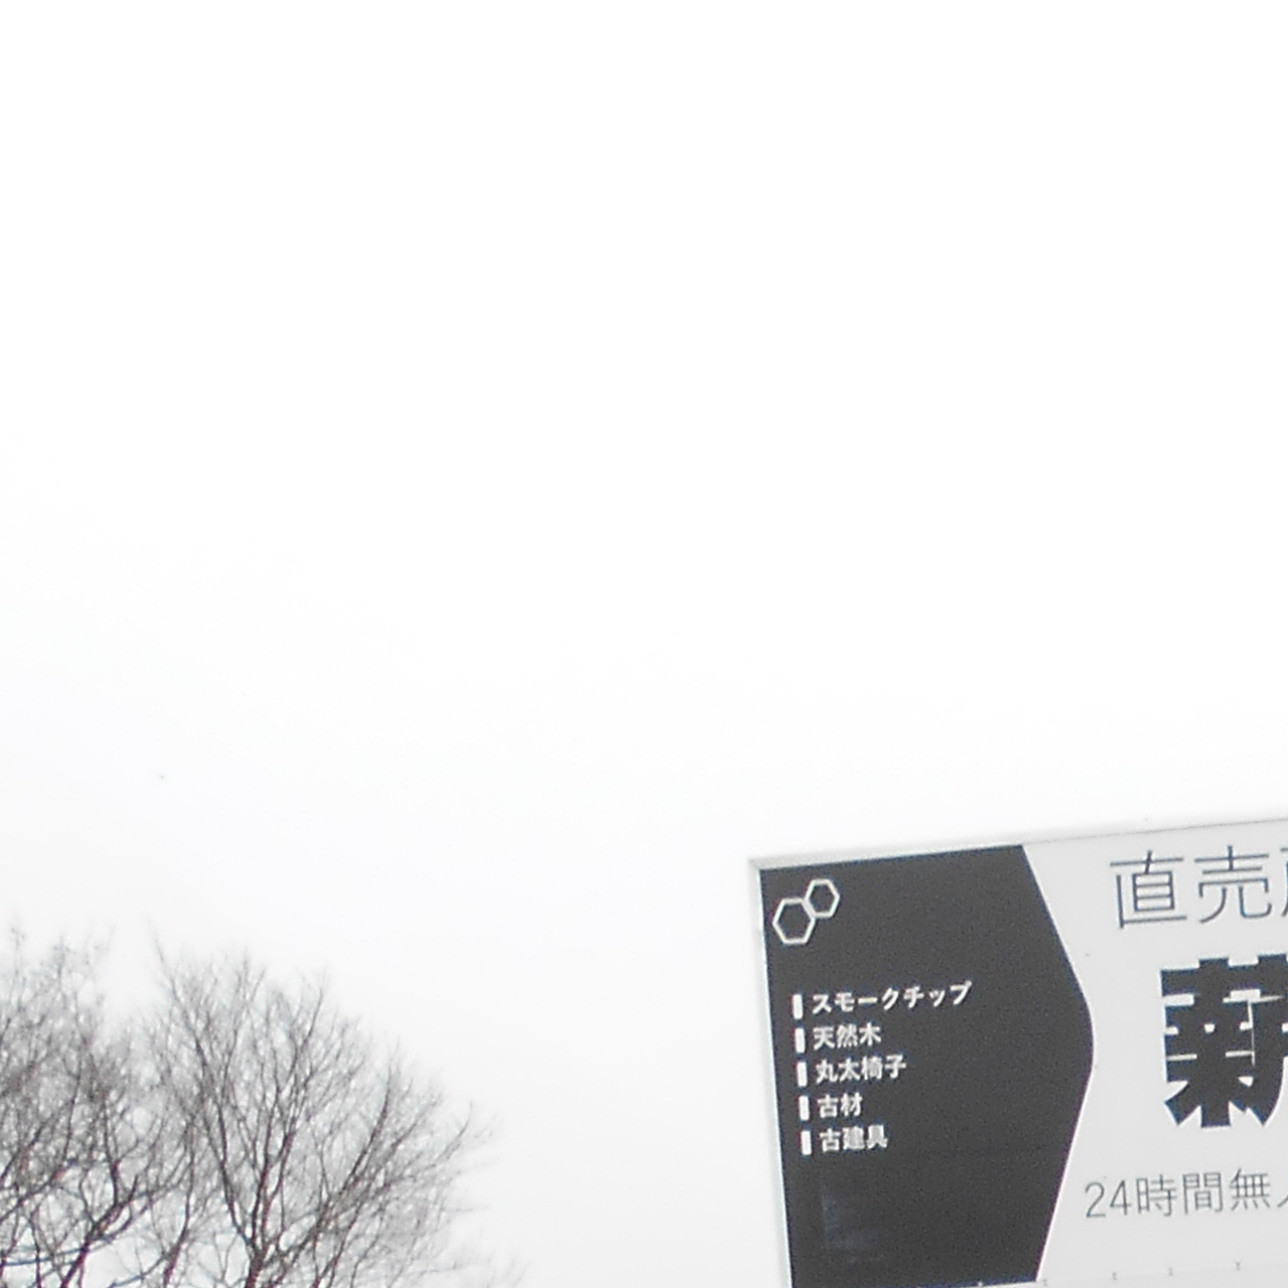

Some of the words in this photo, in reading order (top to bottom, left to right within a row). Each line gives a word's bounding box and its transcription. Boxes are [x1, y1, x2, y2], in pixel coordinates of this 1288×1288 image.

[811, 980, 972, 1015] スモークチップ
[812, 1022, 881, 1050] 天然木
[815, 1055, 907, 1084] 丸太椅子
[817, 1092, 863, 1118] 古材
[819, 1125, 888, 1152] 古建具
